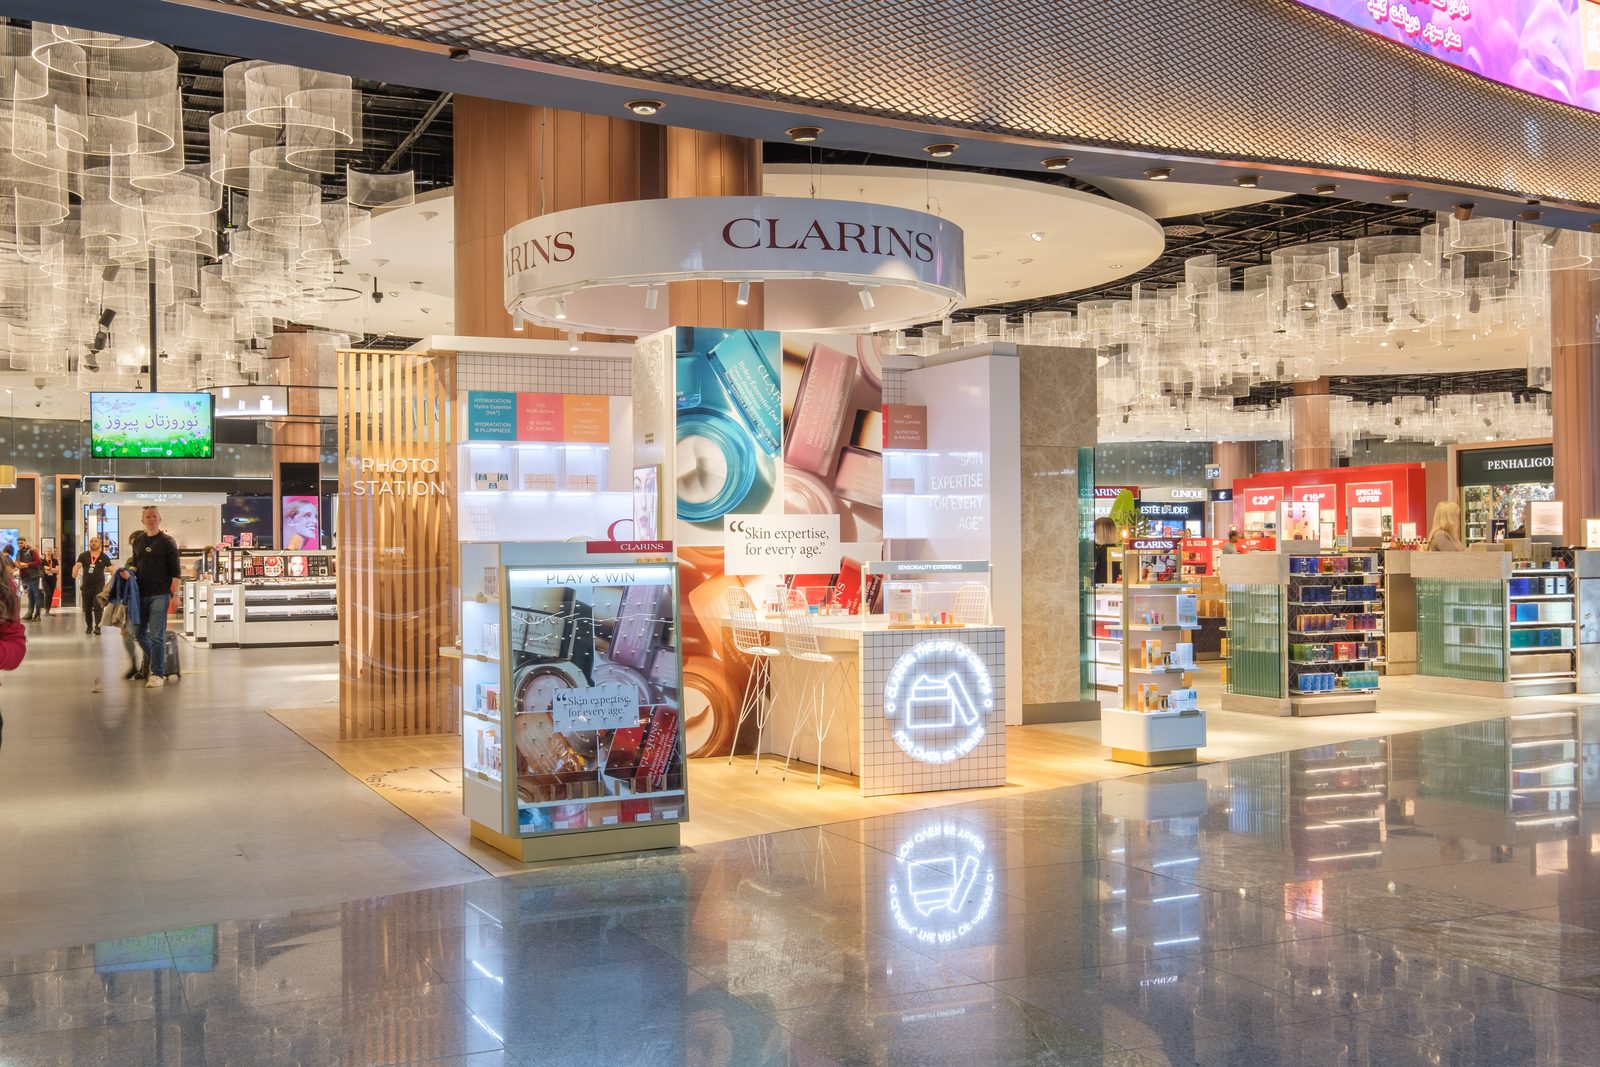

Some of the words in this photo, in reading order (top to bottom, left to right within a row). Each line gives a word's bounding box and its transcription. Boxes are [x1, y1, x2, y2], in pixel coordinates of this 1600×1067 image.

[722, 216, 935, 264] CLARINS
[362, 457, 437, 474] PHOTO
[353, 480, 446, 497] STATION
[931, 473, 983, 491] EXPERTISE
[1171, 489, 1204, 499] CLINIQUE
[1355, 488, 1383, 497] SPECIAL
[1357, 495, 1380, 503] OFFER
[928, 496, 949, 511] FOR
[951, 495, 984, 511] EVERY
[774, 527, 830, 544] expertise,
[620, 543, 664, 551] CLARINS
[745, 542, 762, 557] for
[765, 545, 797, 559] every
[1134, 541, 1173, 549] CLARINS
[546, 572, 584, 585] PLAY
[590, 573, 600, 584] &
[605, 572, 635, 584] WIN
[935, 640, 957, 652] ART
[568, 706, 581, 717] for
[582, 706, 605, 719] every
[639, 721, 661, 768] CLARINS
[913, 747, 942, 762] OVER
